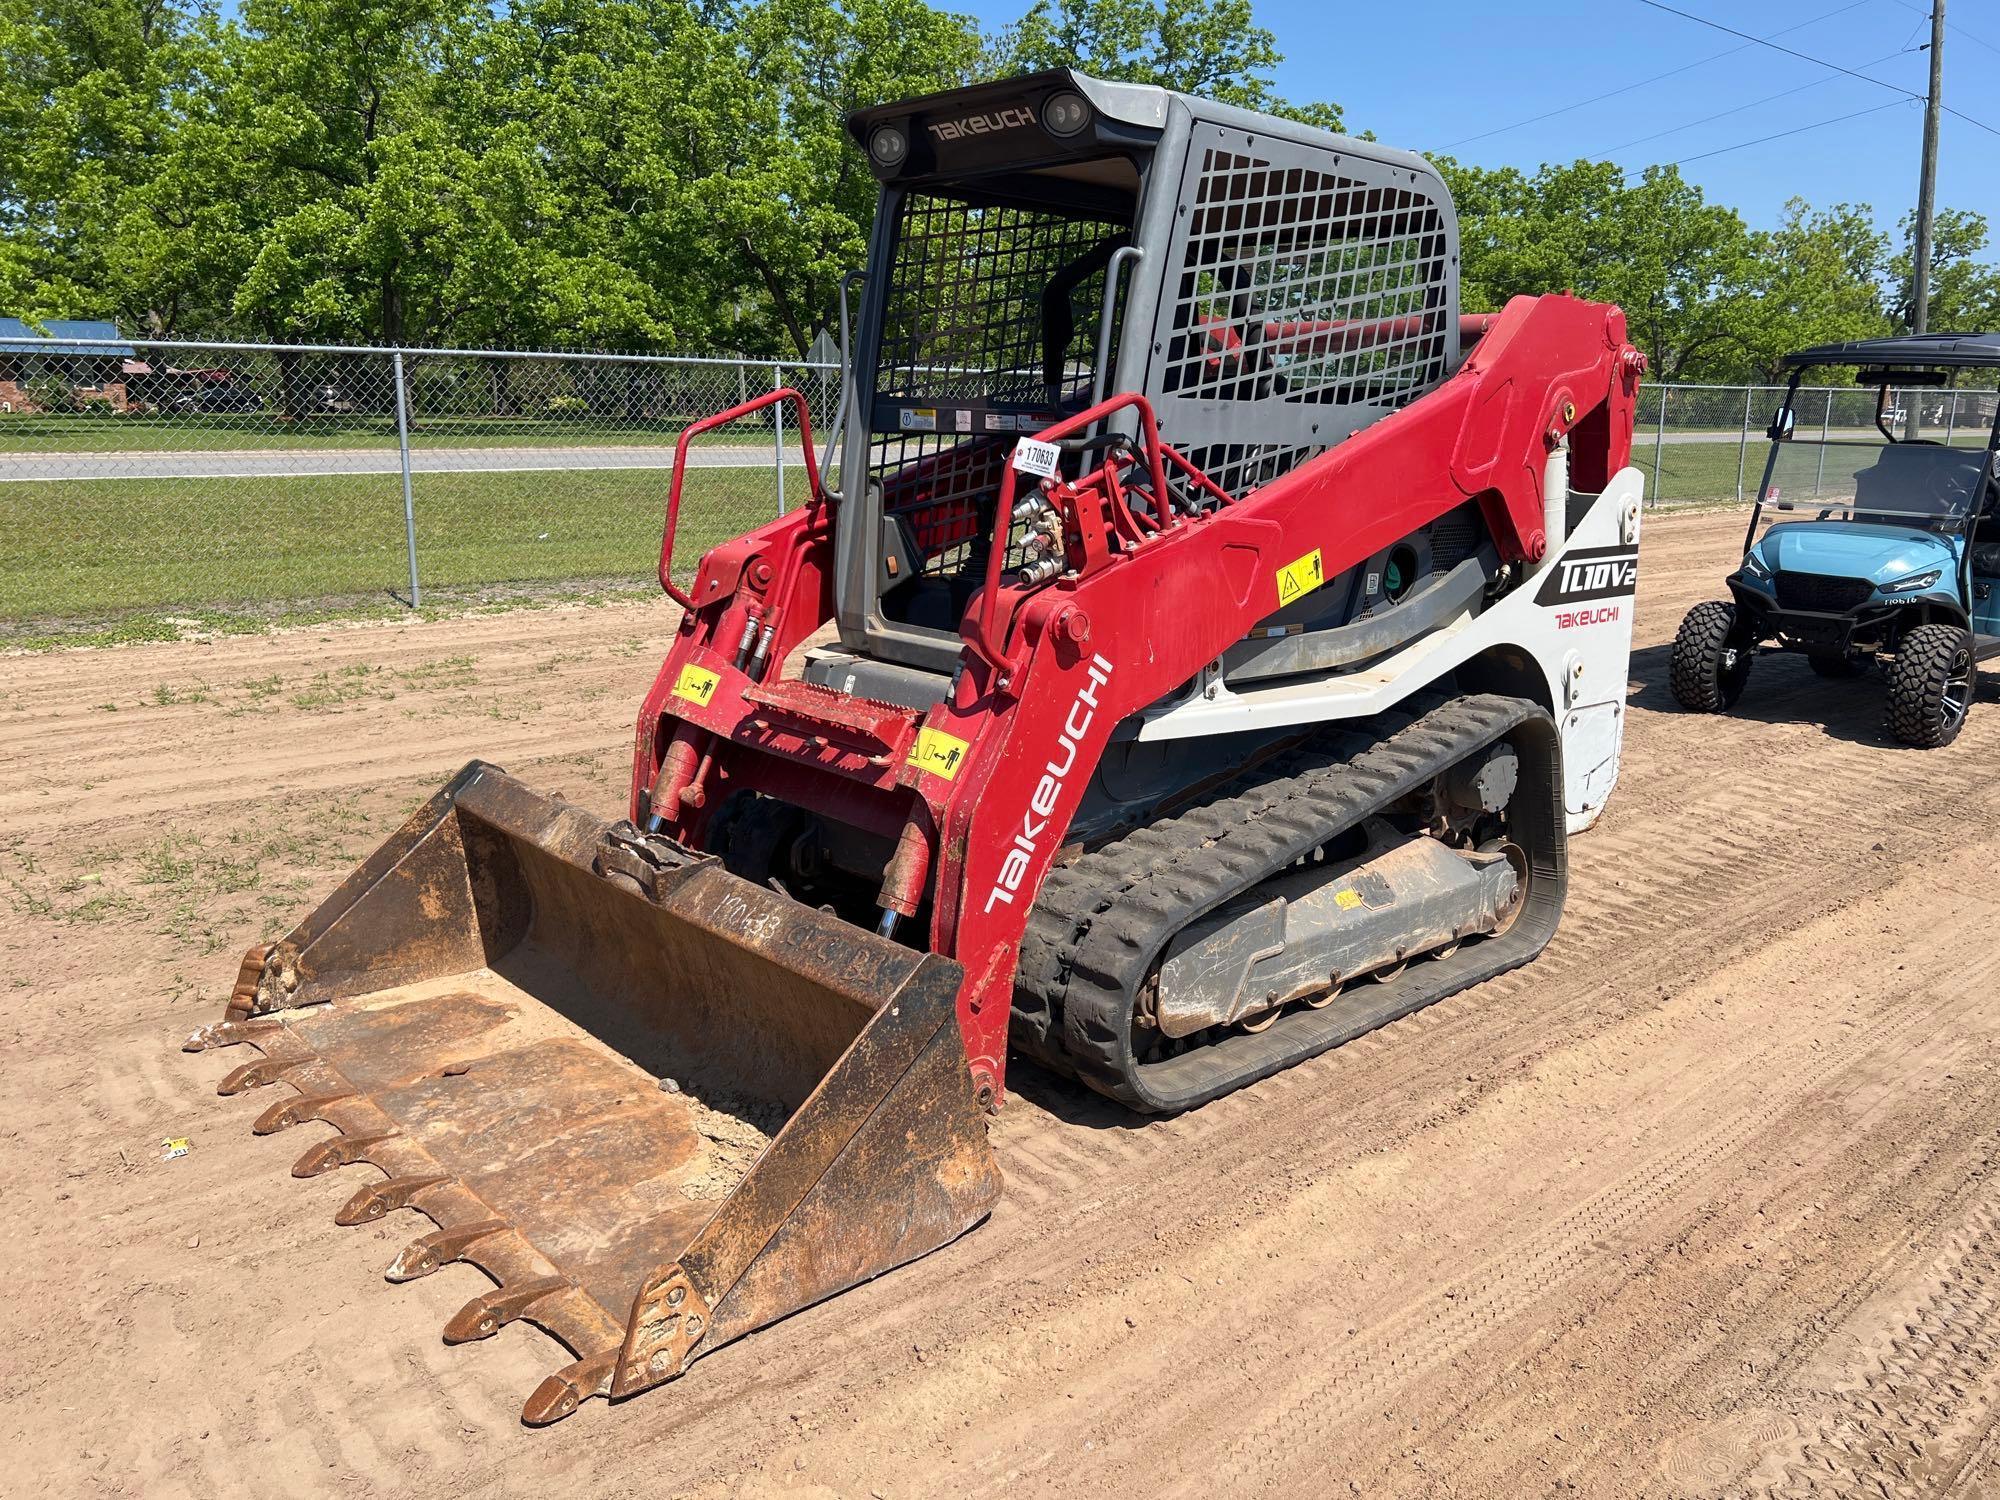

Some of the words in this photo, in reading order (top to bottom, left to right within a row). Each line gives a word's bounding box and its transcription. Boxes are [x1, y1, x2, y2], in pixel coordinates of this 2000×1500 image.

[1027, 446, 1054, 466] 170633
[1560, 554, 1637, 594] TL10V2
[1555, 606, 1619, 630] TAKEUCHI
[983, 652, 1114, 914] TAKEUCHI
